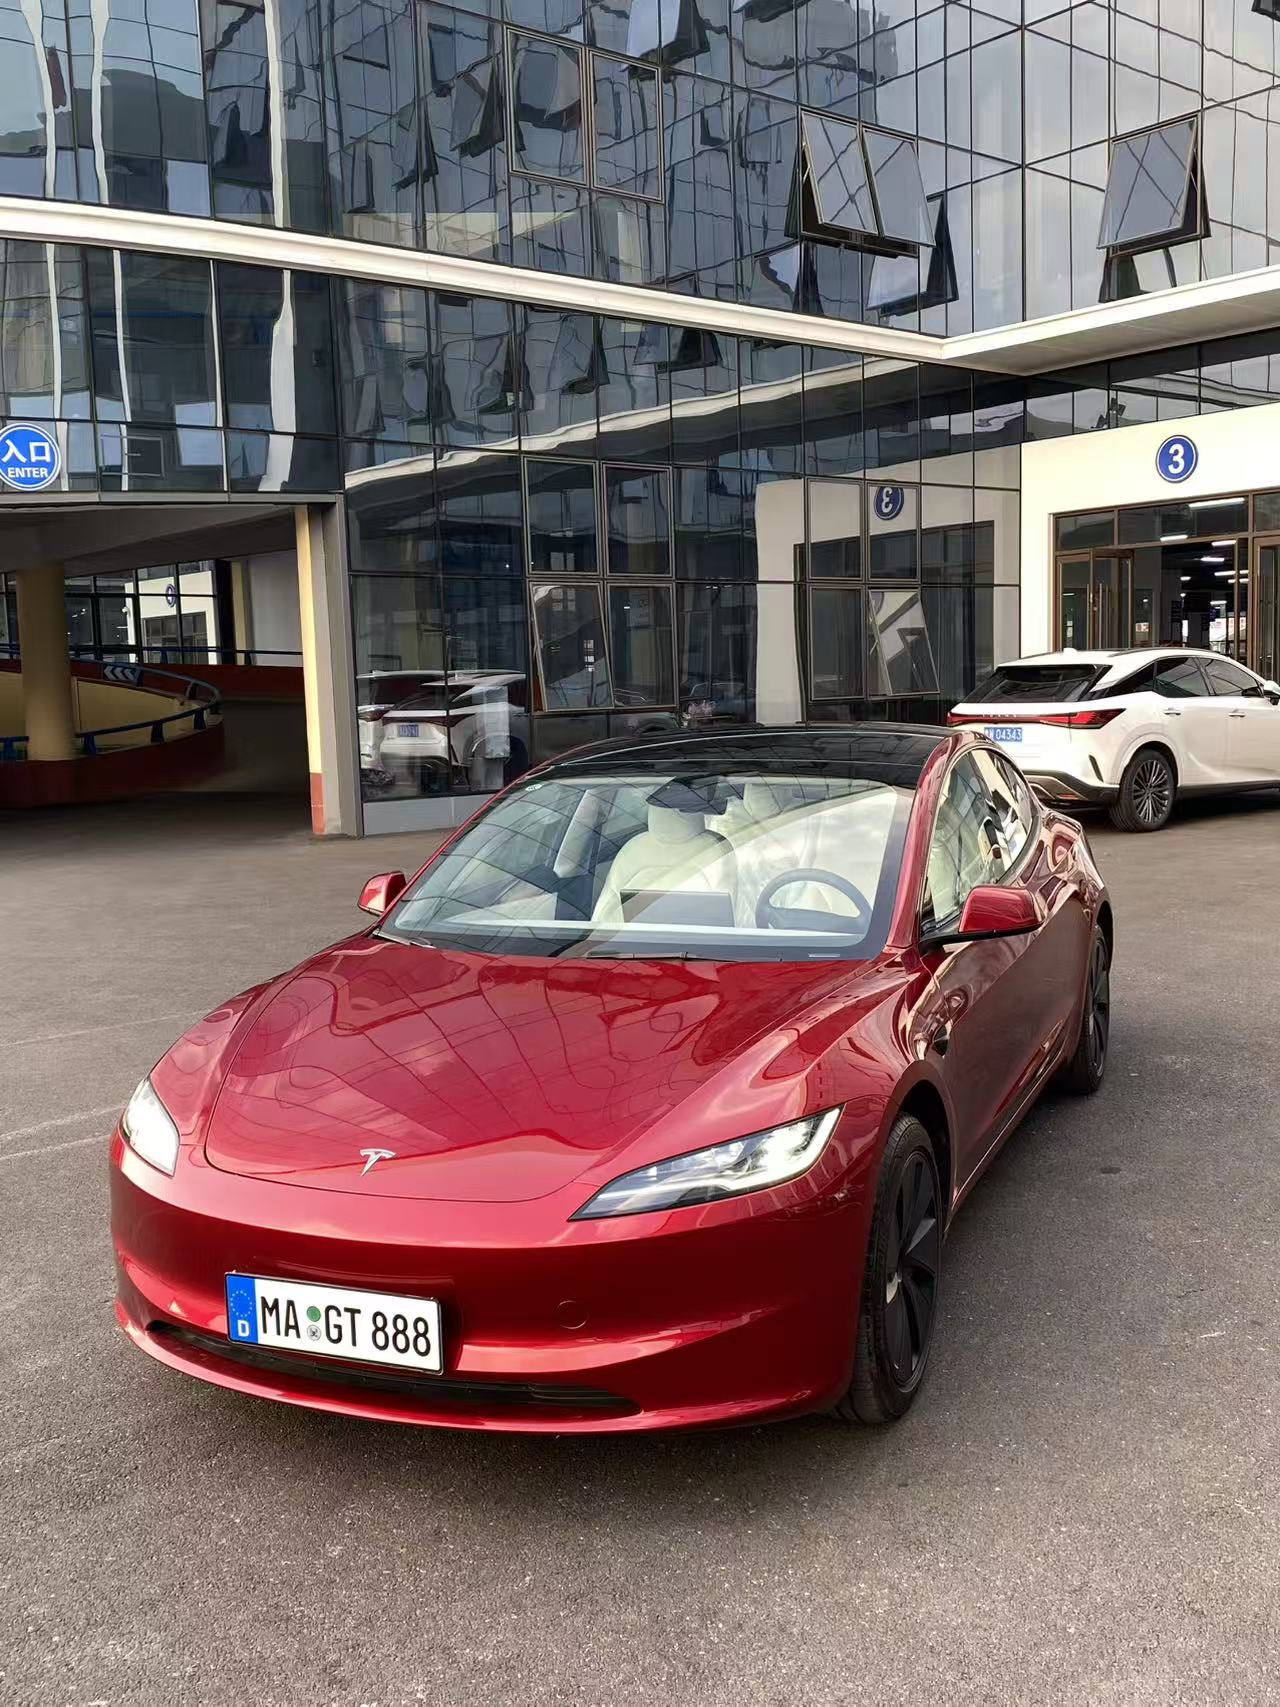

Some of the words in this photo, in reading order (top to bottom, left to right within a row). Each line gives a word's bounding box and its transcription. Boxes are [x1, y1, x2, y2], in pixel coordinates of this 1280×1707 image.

[1, 439, 51, 463] 入口
[1168, 443, 1185, 474] 3
[7, 467, 48, 478] ENTER
[237, 1320, 250, 1337] D
[260, 1296, 301, 1339] MA
[324, 1304, 361, 1347] GT
[371, 1311, 431, 1357] 888
